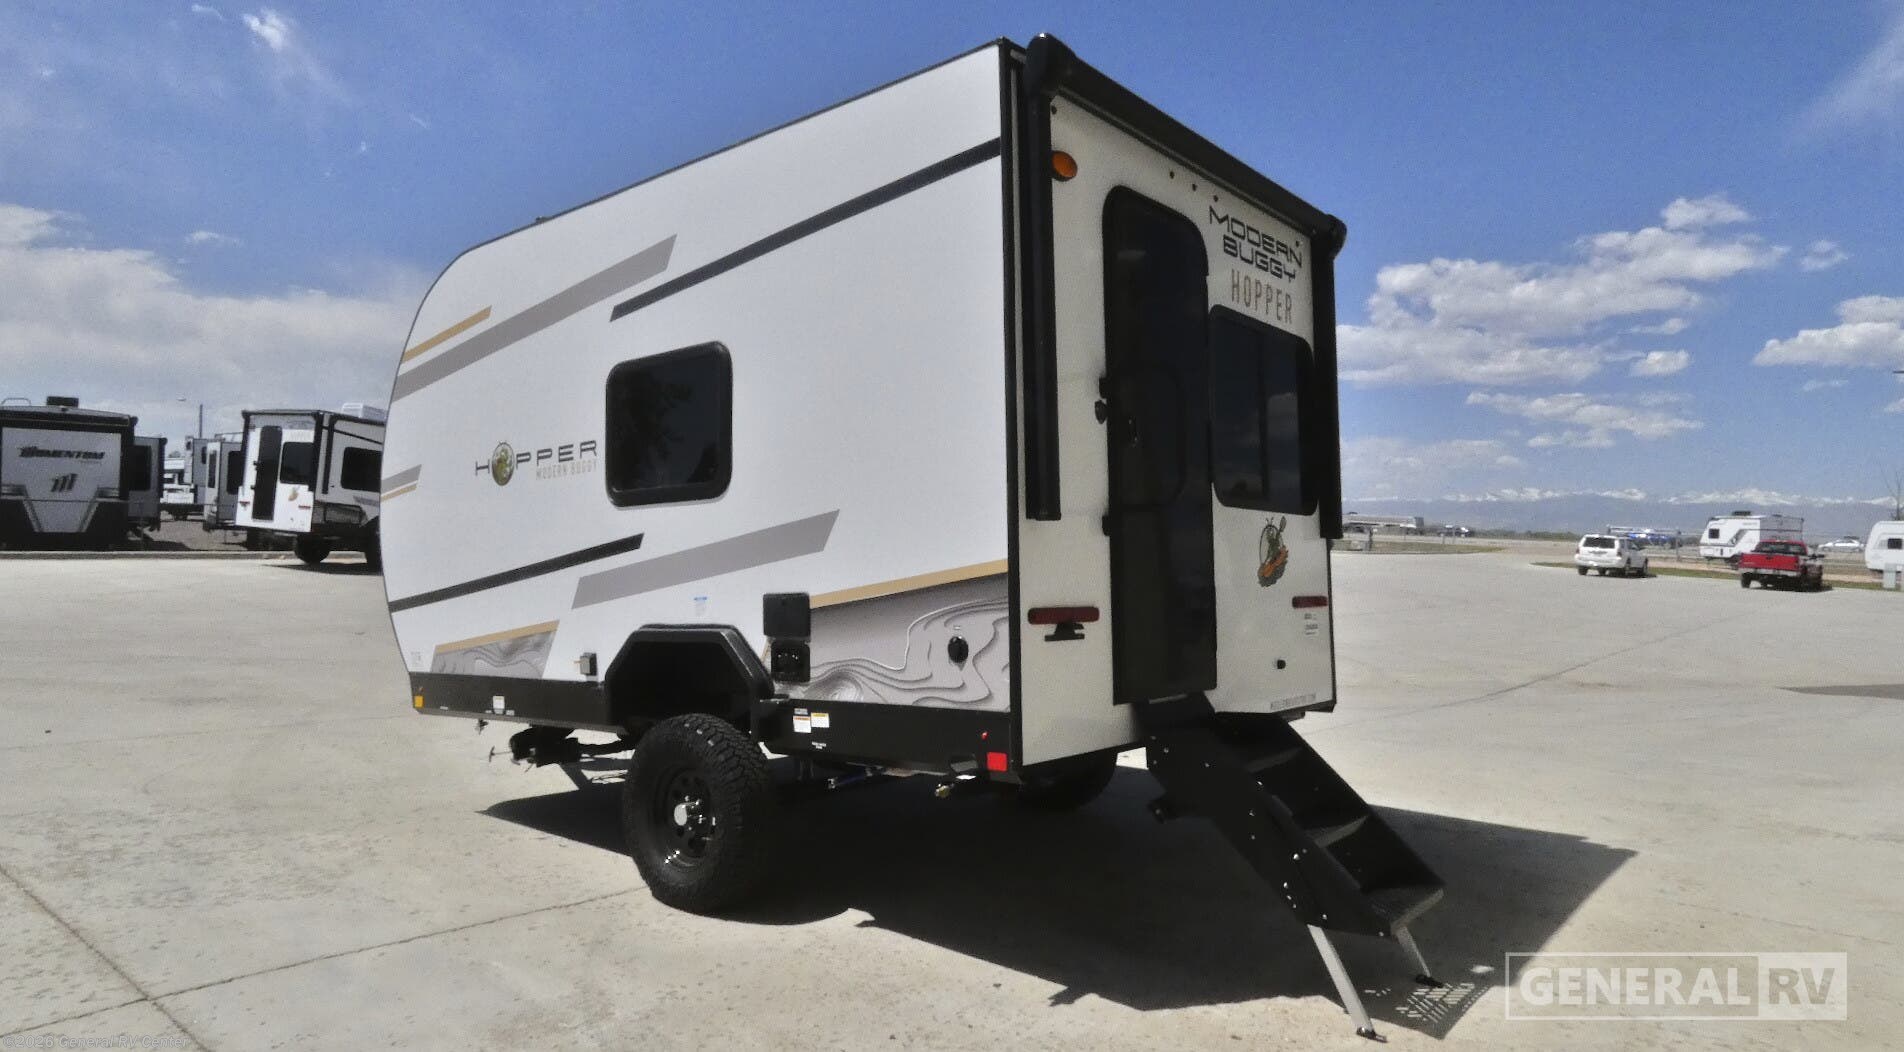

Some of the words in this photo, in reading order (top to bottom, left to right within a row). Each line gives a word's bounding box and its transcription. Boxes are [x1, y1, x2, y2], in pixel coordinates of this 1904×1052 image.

[1209, 205, 1302, 268] MODERN
[1223, 234, 1296, 284] BUGGY
[1231, 268, 1293, 324] HOPPER
